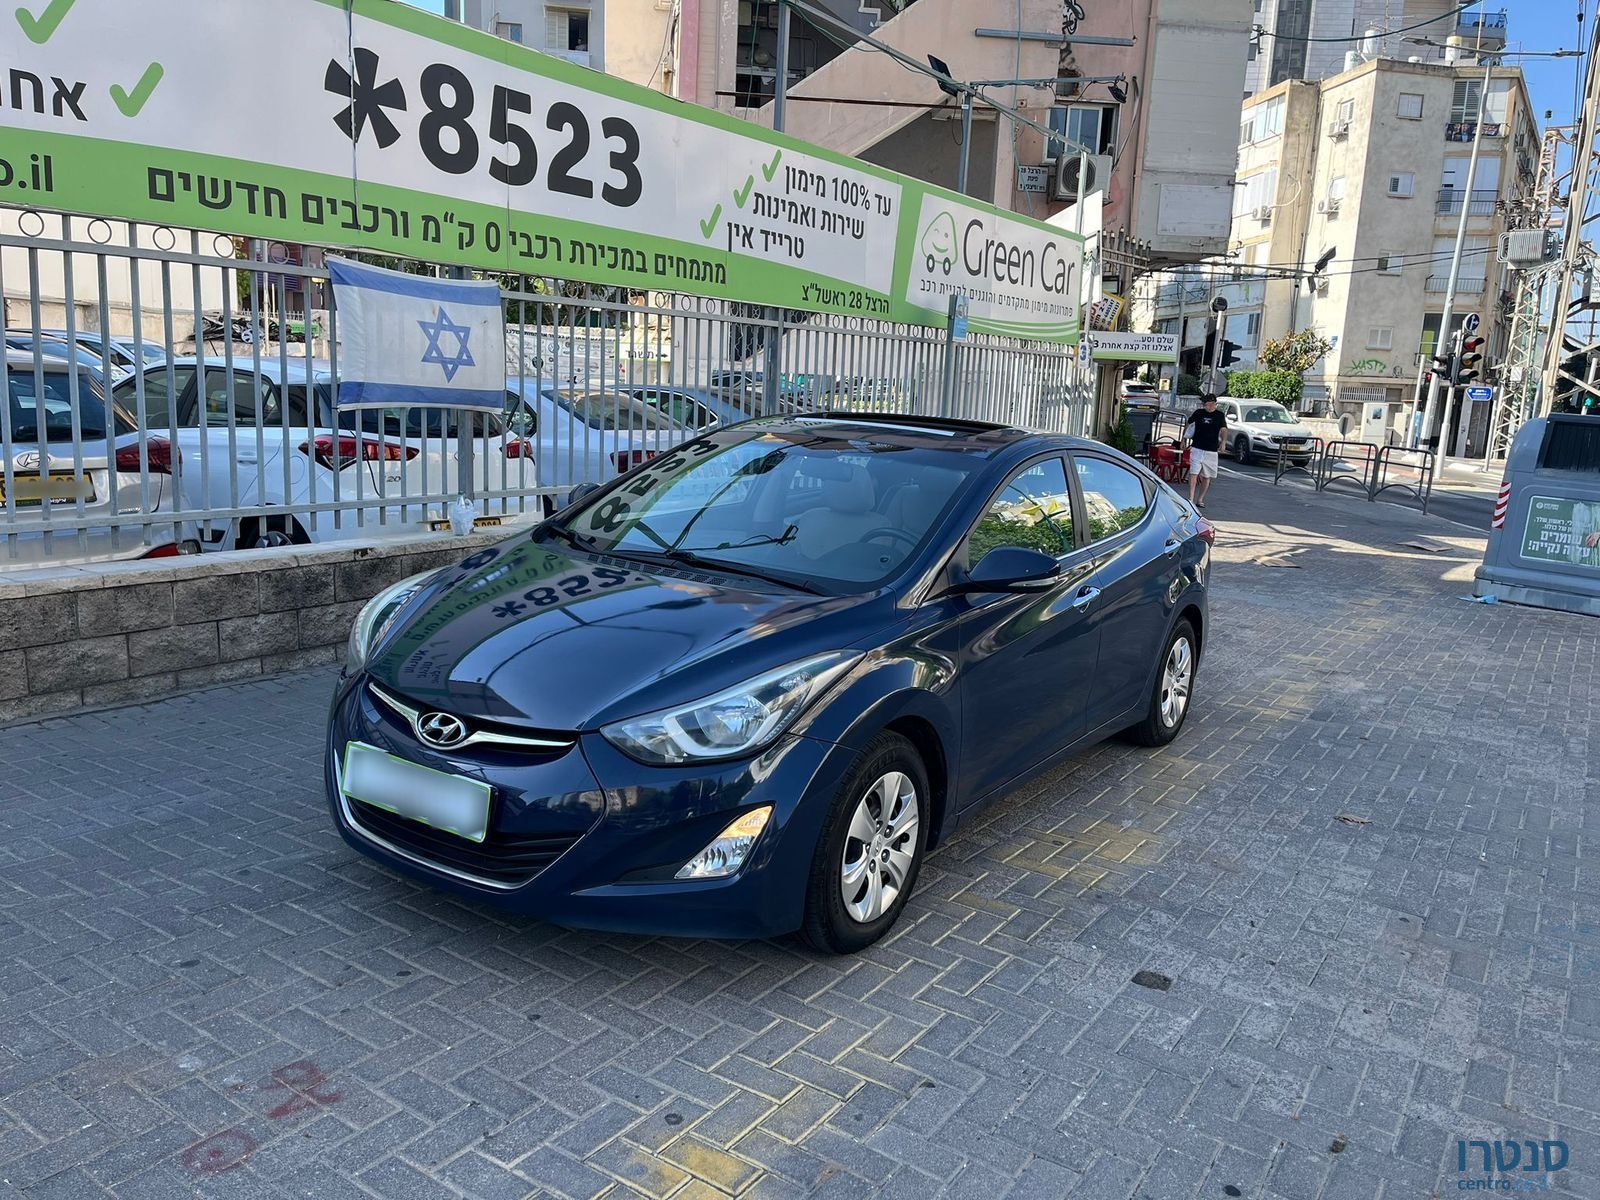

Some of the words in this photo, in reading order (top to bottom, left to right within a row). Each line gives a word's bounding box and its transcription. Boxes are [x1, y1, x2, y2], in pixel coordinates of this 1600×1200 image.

[0, 68, 88, 122] אח
[147, 166, 288, 220] חדשים
[785, 165, 827, 199] מימון
[831, 177, 871, 211] 100%
[301, 192, 410, 240] ורכבים
[752, 191, 816, 229] ואמינות
[874, 193, 892, 217] עד
[485, 220, 501, 253] 0
[727, 221, 755, 253] אין
[820, 209, 865, 240] שירות
[508, 230, 562, 262] רכבי
[568, 239, 649, 274] במכירת
[759, 228, 805, 259] טרייד
[963, 218, 1035, 288] Green
[1041, 241, 1075, 296] Car
[654, 253, 727, 285] מתמחים
[801, 282, 846, 308] ראשל"צ
[849, 290, 863, 310] 28
[920, 278, 937, 295] רכב
[865, 292, 890, 314] הרצל
[998, 294, 1029, 311] מתקדמים
[1101, 341, 1122, 350] אחרת
[1123, 343, 1140, 352] קצת
[1152, 344, 1173, 352] אצלנו
[1156, 336, 1174, 344] שלם
[1528, 540, 1561, 555] נקייה!
[1540, 530, 1583, 545] שומרים
